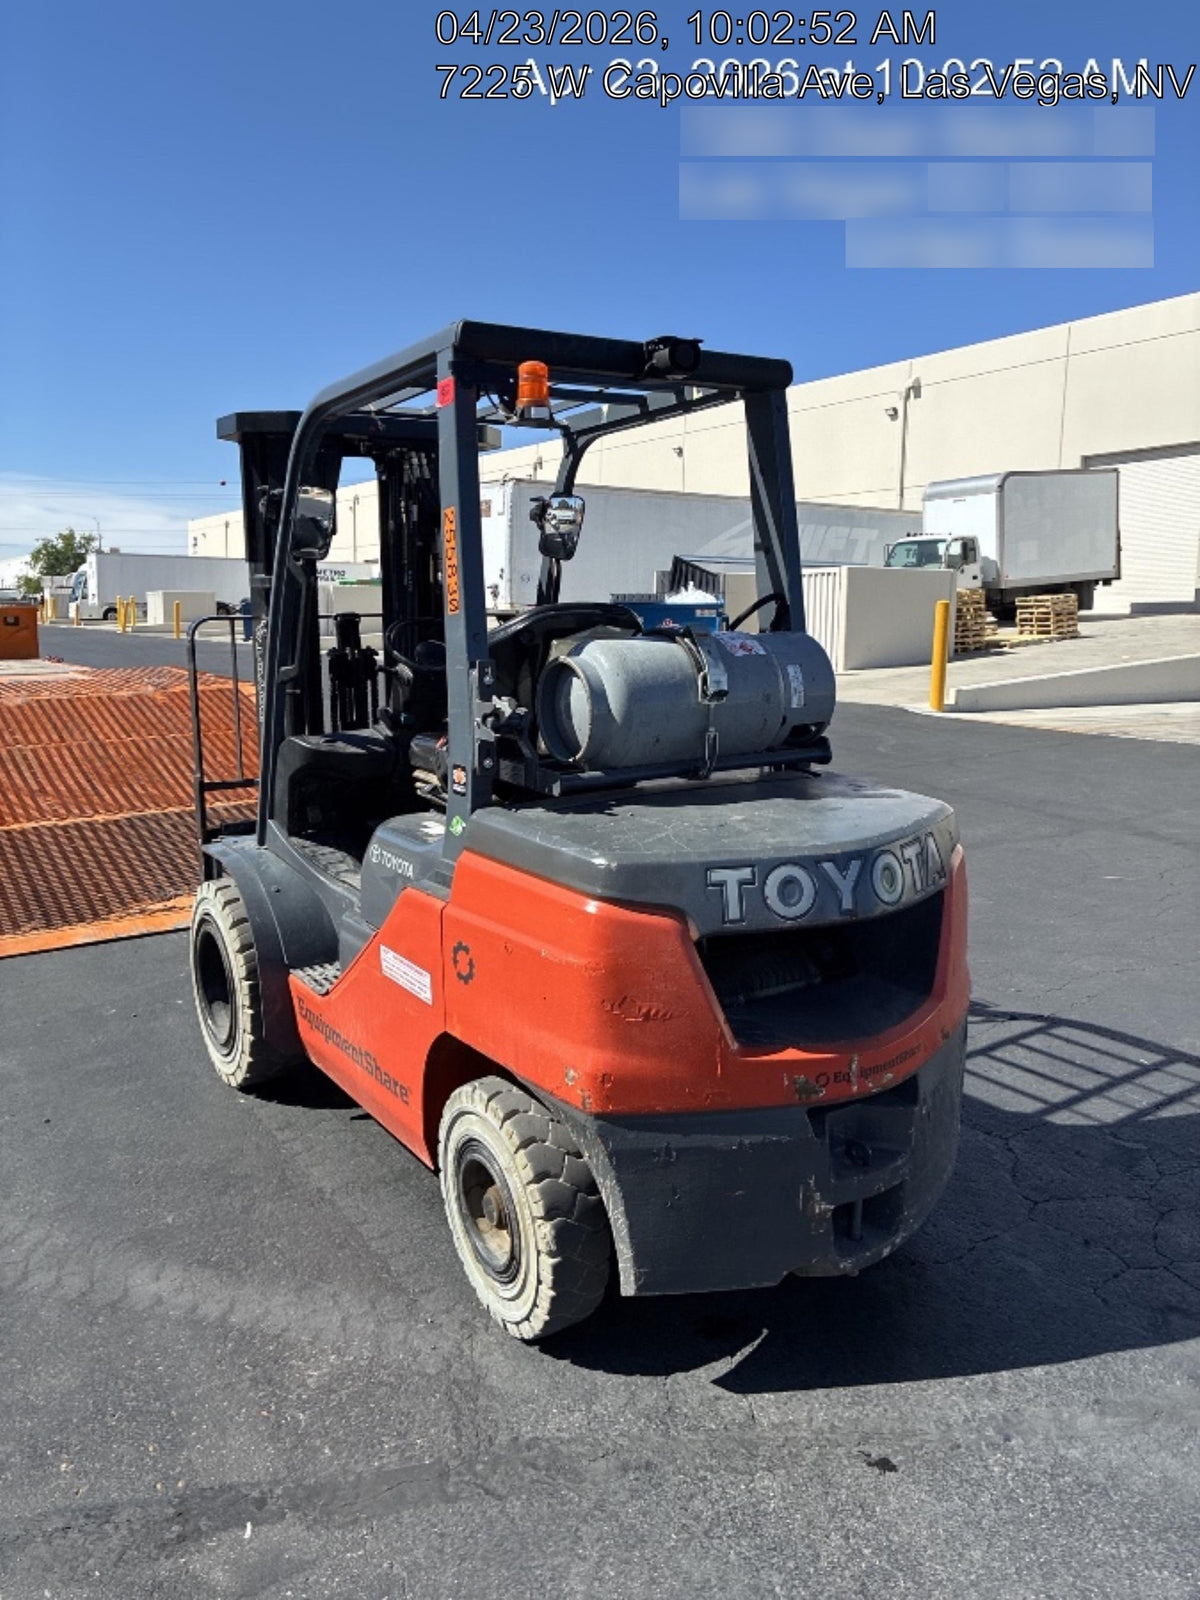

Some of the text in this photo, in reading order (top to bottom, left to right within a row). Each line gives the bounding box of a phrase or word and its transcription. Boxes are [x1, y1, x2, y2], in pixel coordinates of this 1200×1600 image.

[382, 850, 415, 880] TOYOTA
[706, 831, 947, 925] TOYOTA
[297, 997, 411, 1106] EquipmentShare
